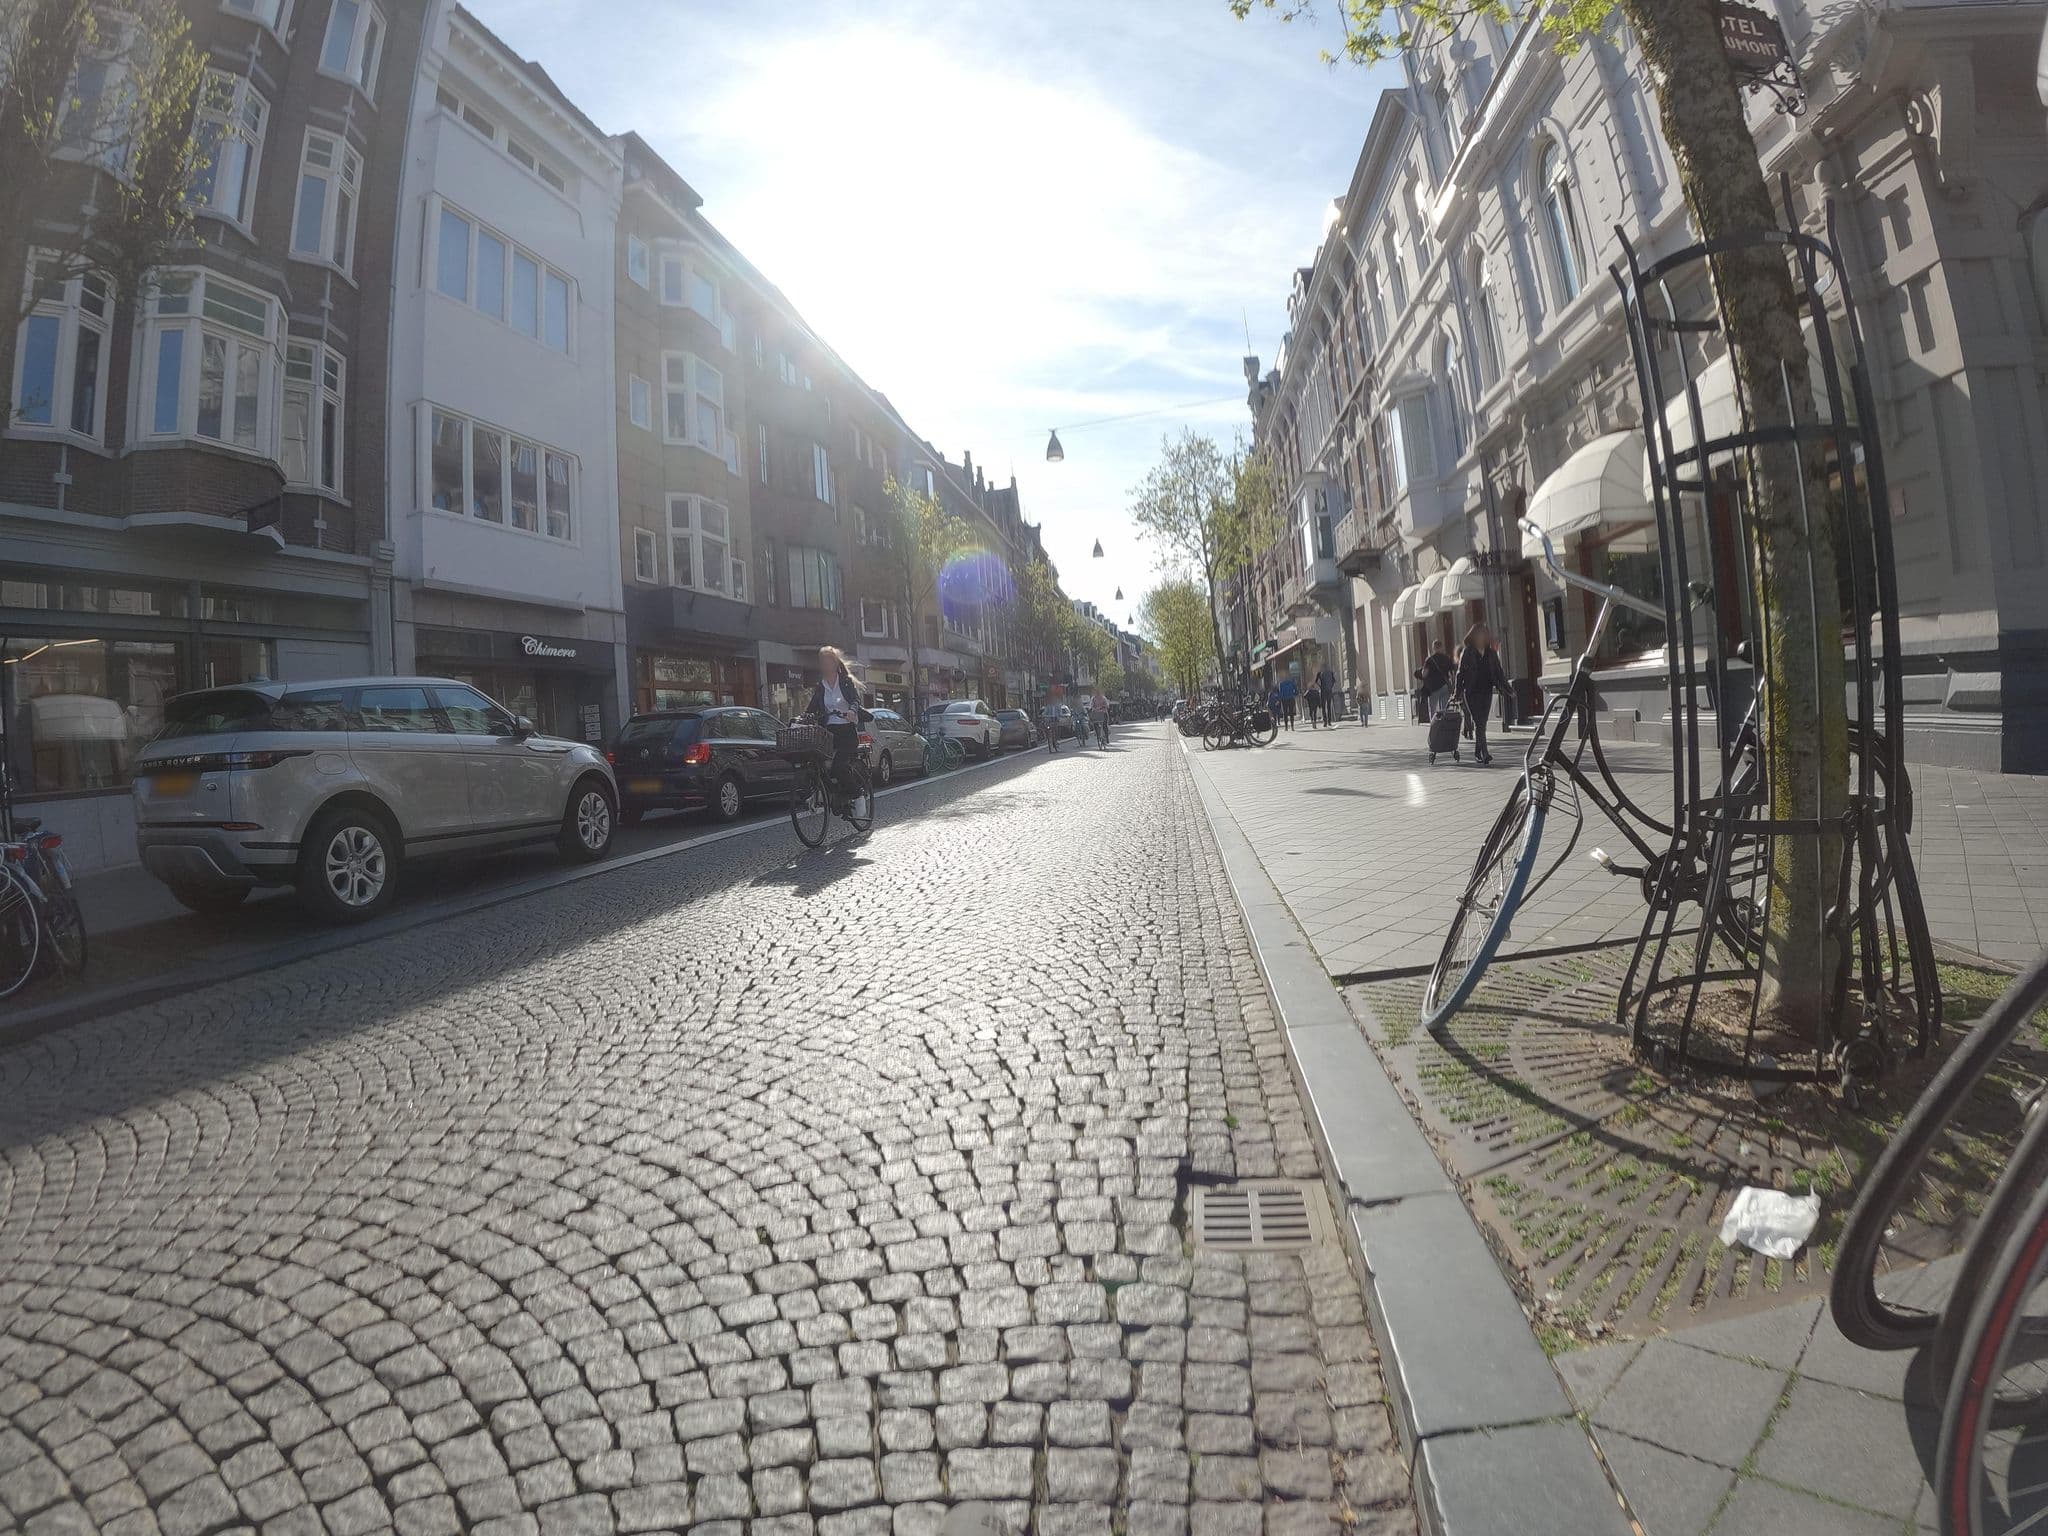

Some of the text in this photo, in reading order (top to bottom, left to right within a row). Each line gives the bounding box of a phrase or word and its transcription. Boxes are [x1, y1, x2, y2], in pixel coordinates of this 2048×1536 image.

[1721, 16, 1764, 36] TEL
[1724, 36, 1778, 57] UMONT
[521, 635, 577, 658] Chimera
